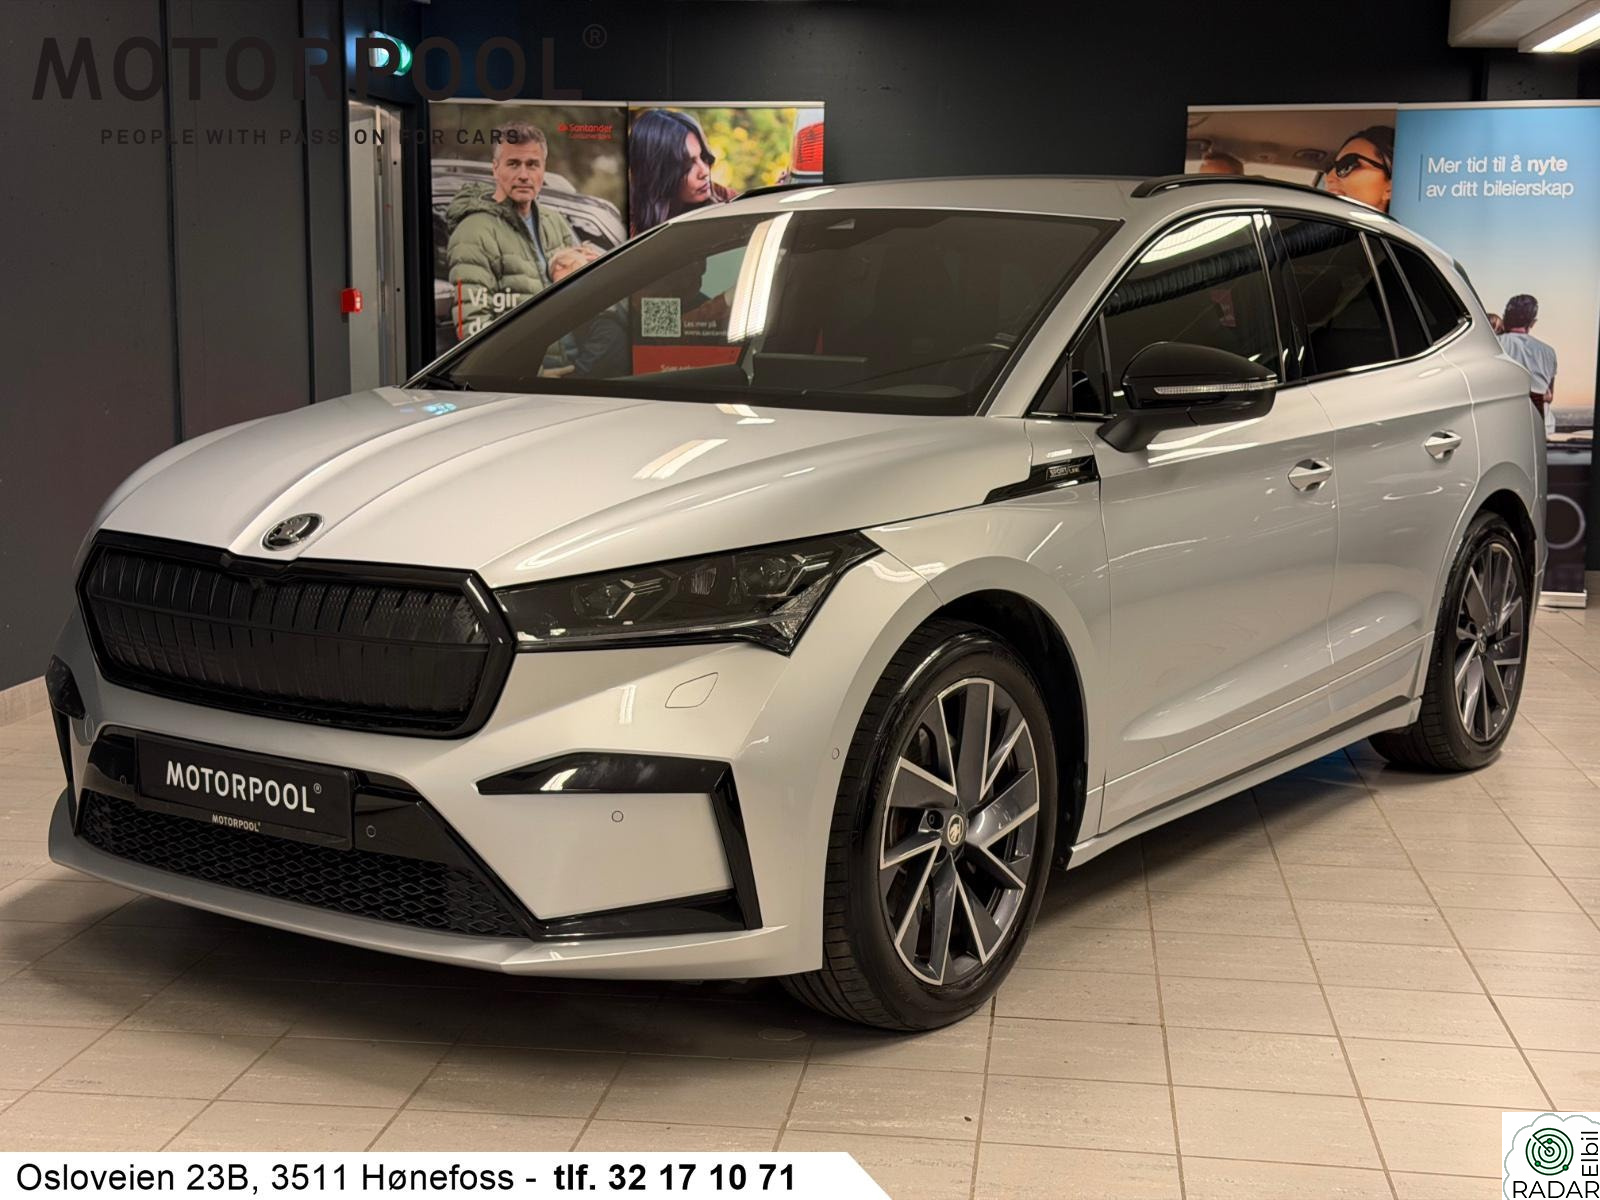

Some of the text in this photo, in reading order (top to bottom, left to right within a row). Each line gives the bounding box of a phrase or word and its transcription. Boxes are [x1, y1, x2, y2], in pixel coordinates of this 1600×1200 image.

[569, 122, 613, 133] Santander
[1427, 155, 1568, 176] Mer tid til å nyte
[1425, 180, 1575, 198] av ditt bileierskap
[468, 287, 521, 313] Vi gir
